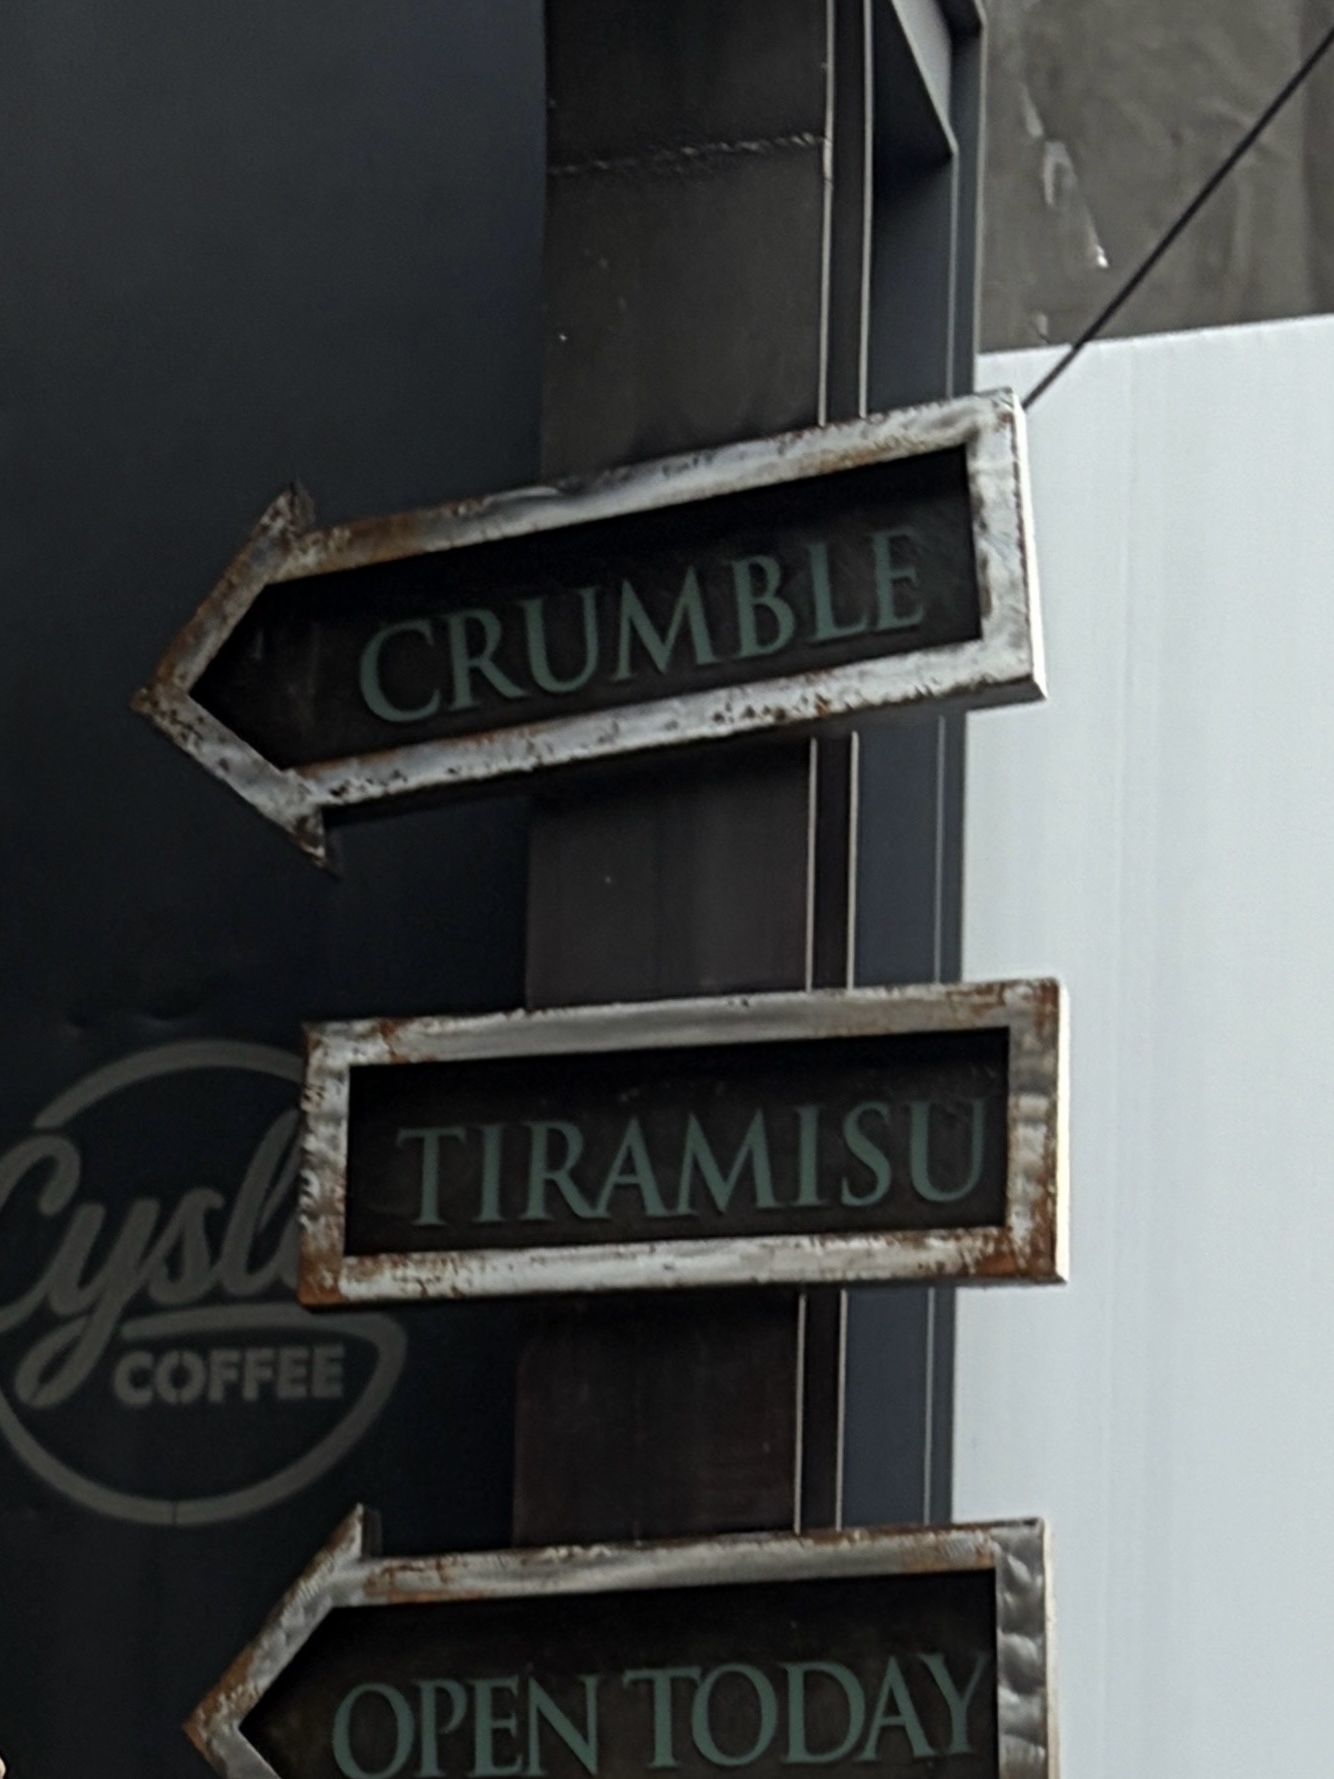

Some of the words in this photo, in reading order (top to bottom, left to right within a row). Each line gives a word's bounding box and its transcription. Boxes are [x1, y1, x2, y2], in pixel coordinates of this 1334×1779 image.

[358, 528, 926, 724] CRUMBLE
[397, 1096, 989, 1227] TIRAMISU
[111, 1343, 345, 1404] COFFEE
[623, 1652, 986, 1771] TODAY
